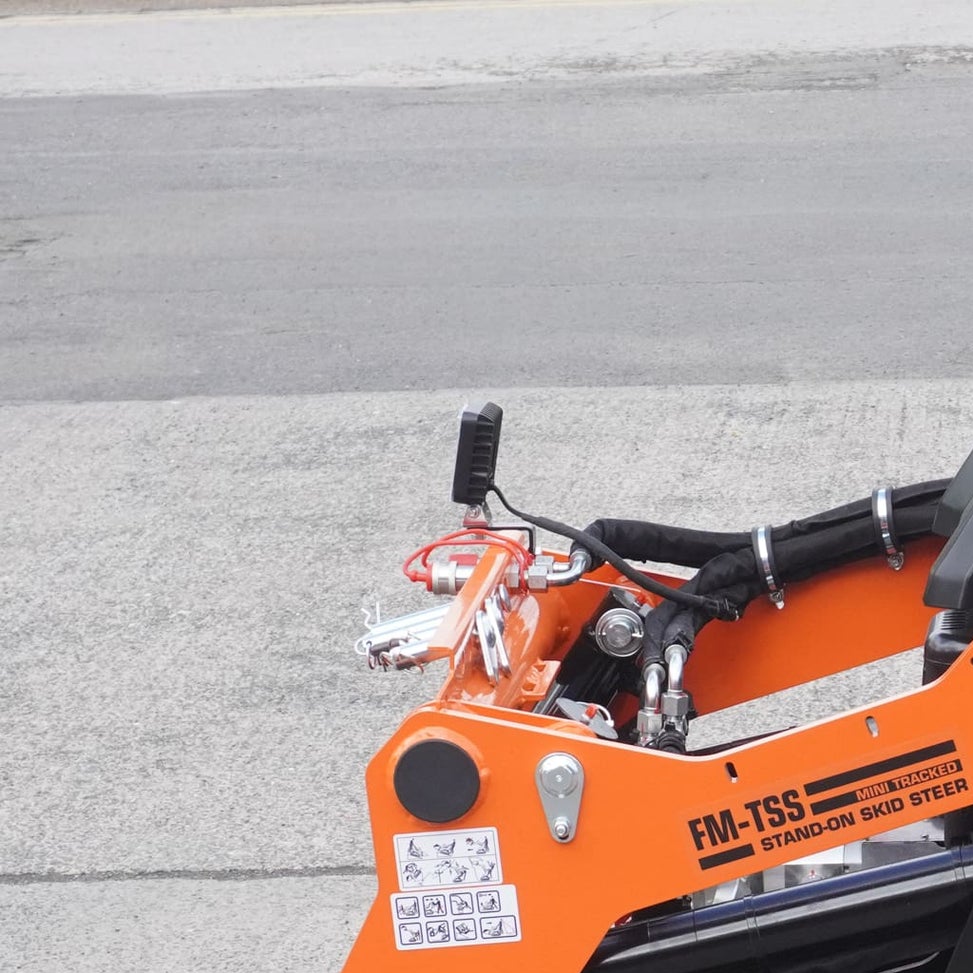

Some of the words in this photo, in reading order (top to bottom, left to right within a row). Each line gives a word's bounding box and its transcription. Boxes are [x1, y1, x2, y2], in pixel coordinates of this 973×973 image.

[855, 782, 890, 801] MINI
[892, 761, 958, 789] TRACKED
[688, 789, 806, 851] FM-TSS
[760, 811, 856, 851] STAND-ON
[860, 797, 905, 822] SKID
[909, 778, 969, 806] STEER
